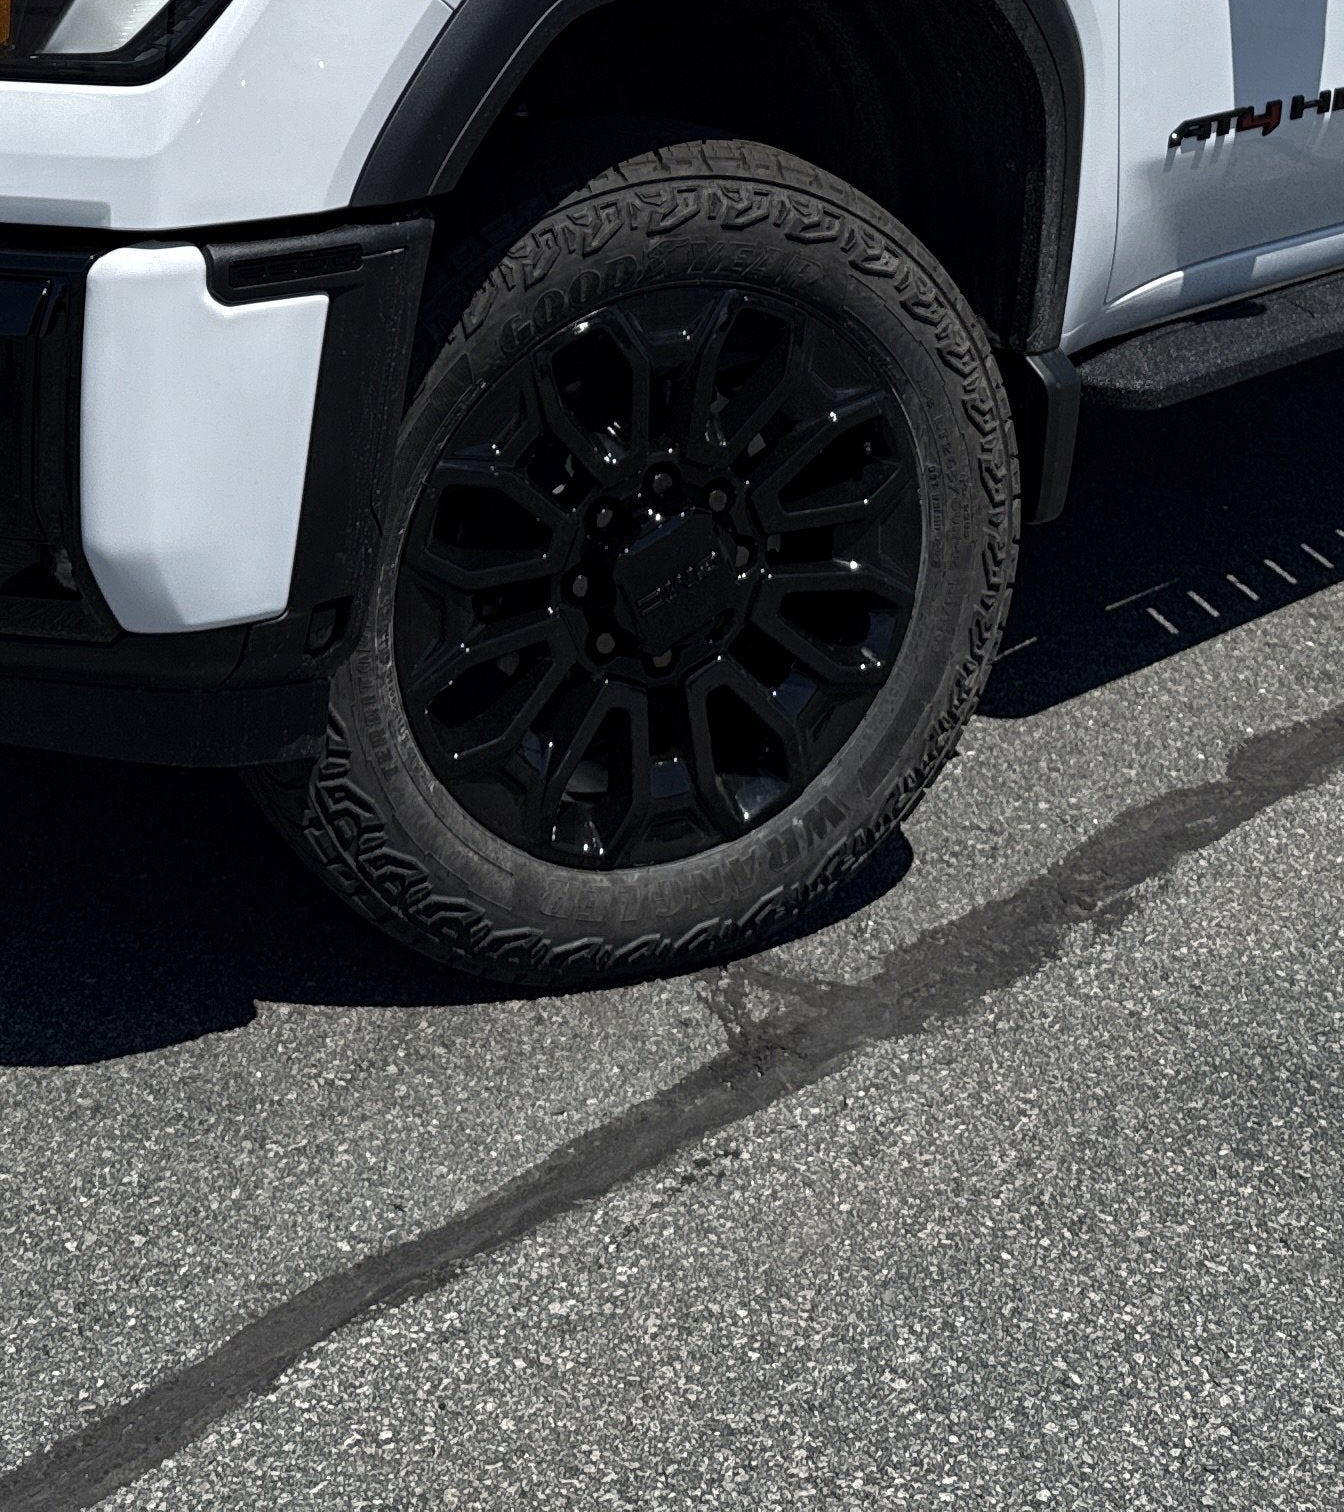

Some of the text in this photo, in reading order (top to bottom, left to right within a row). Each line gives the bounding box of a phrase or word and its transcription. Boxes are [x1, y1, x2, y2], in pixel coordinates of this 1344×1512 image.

[1168, 99, 1283, 149] AT4
[498, 237, 828, 355] GOODYEAR
[538, 796, 849, 924] WRANGLER
